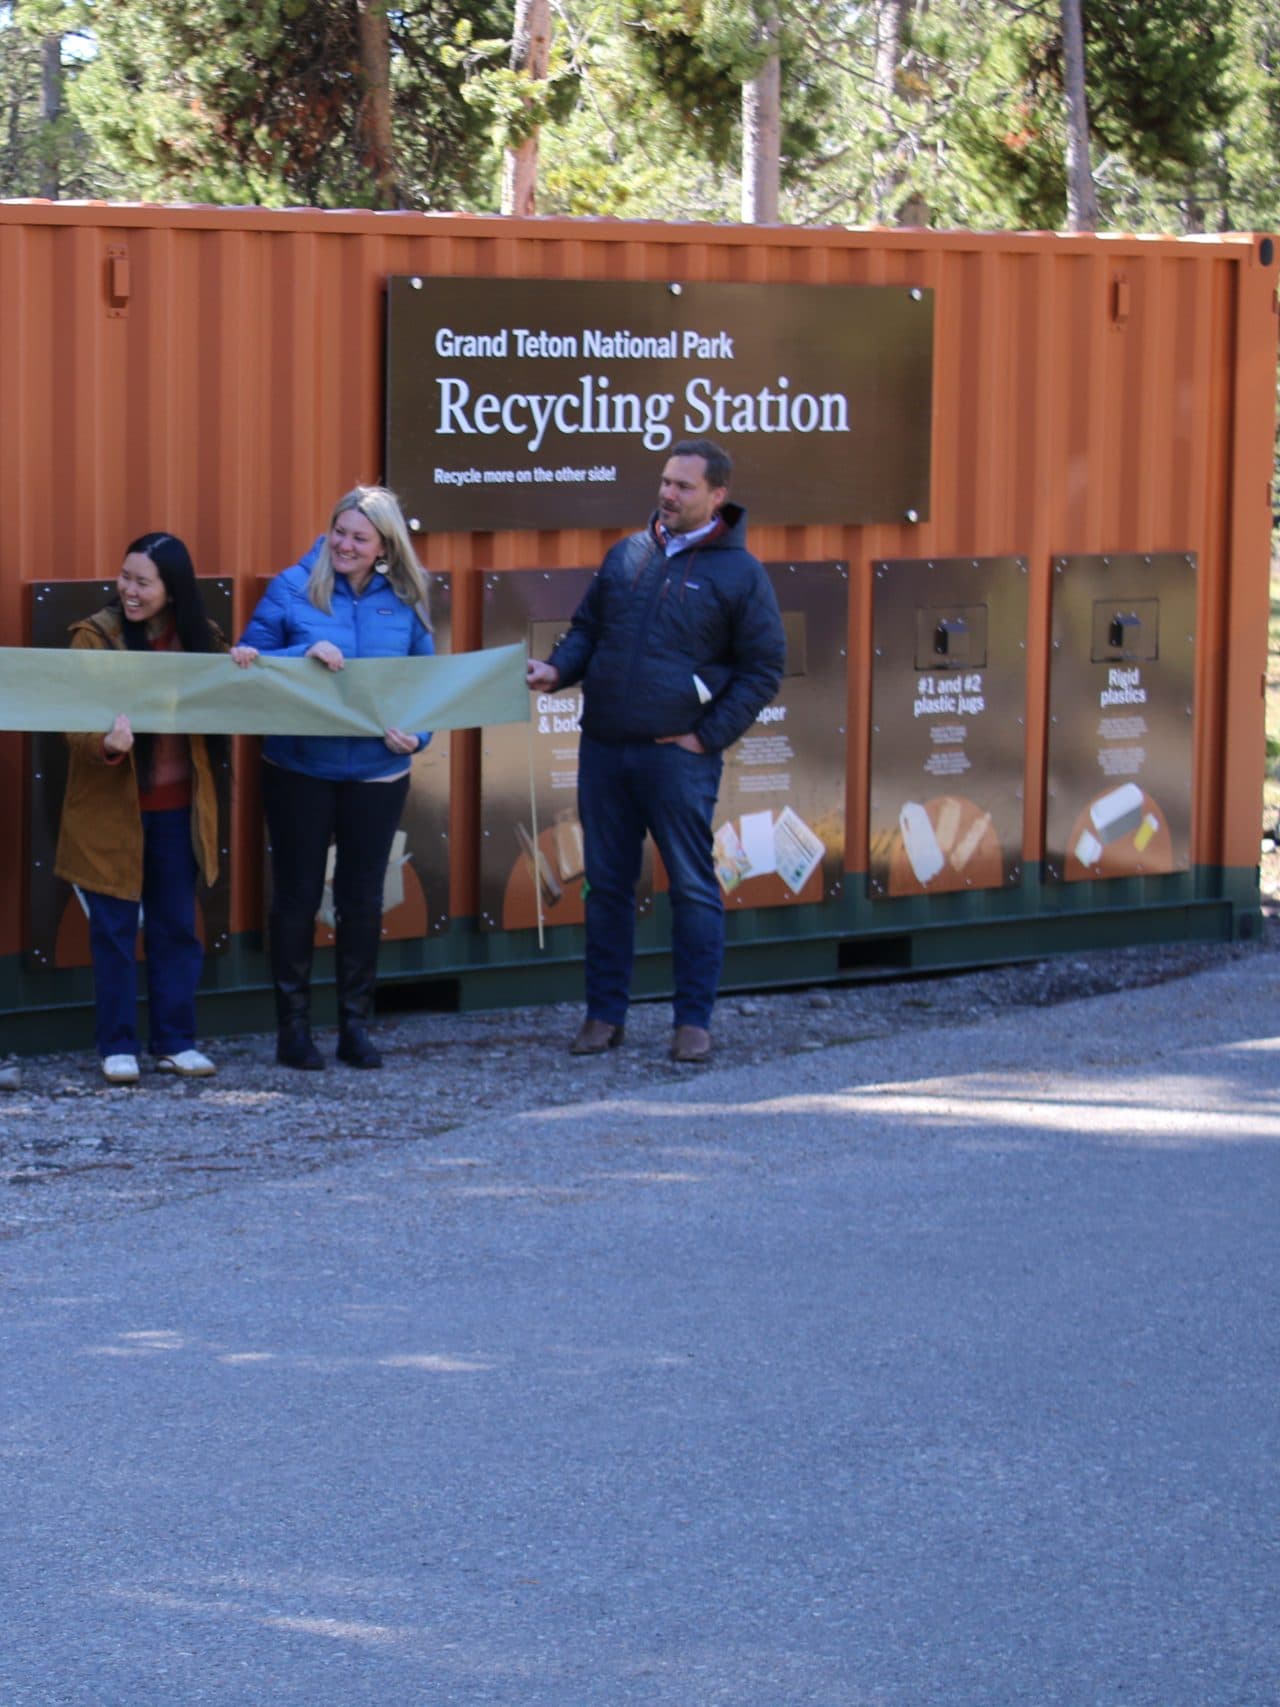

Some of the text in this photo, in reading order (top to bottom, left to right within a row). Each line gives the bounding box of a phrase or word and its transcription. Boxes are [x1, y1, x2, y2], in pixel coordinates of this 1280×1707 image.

[435, 327, 734, 359] Grand Teton National Park
[435, 374, 851, 452] Recycling Station
[434, 465, 616, 486] Recycle more on the other side!
[918, 673, 982, 695] #1 and #2
[1108, 667, 1140, 688] Rigid
[537, 694, 576, 713] Glass
[914, 693, 985, 719] plastic jugs
[1101, 686, 1147, 709] plastics
[538, 715, 551, 733] &
